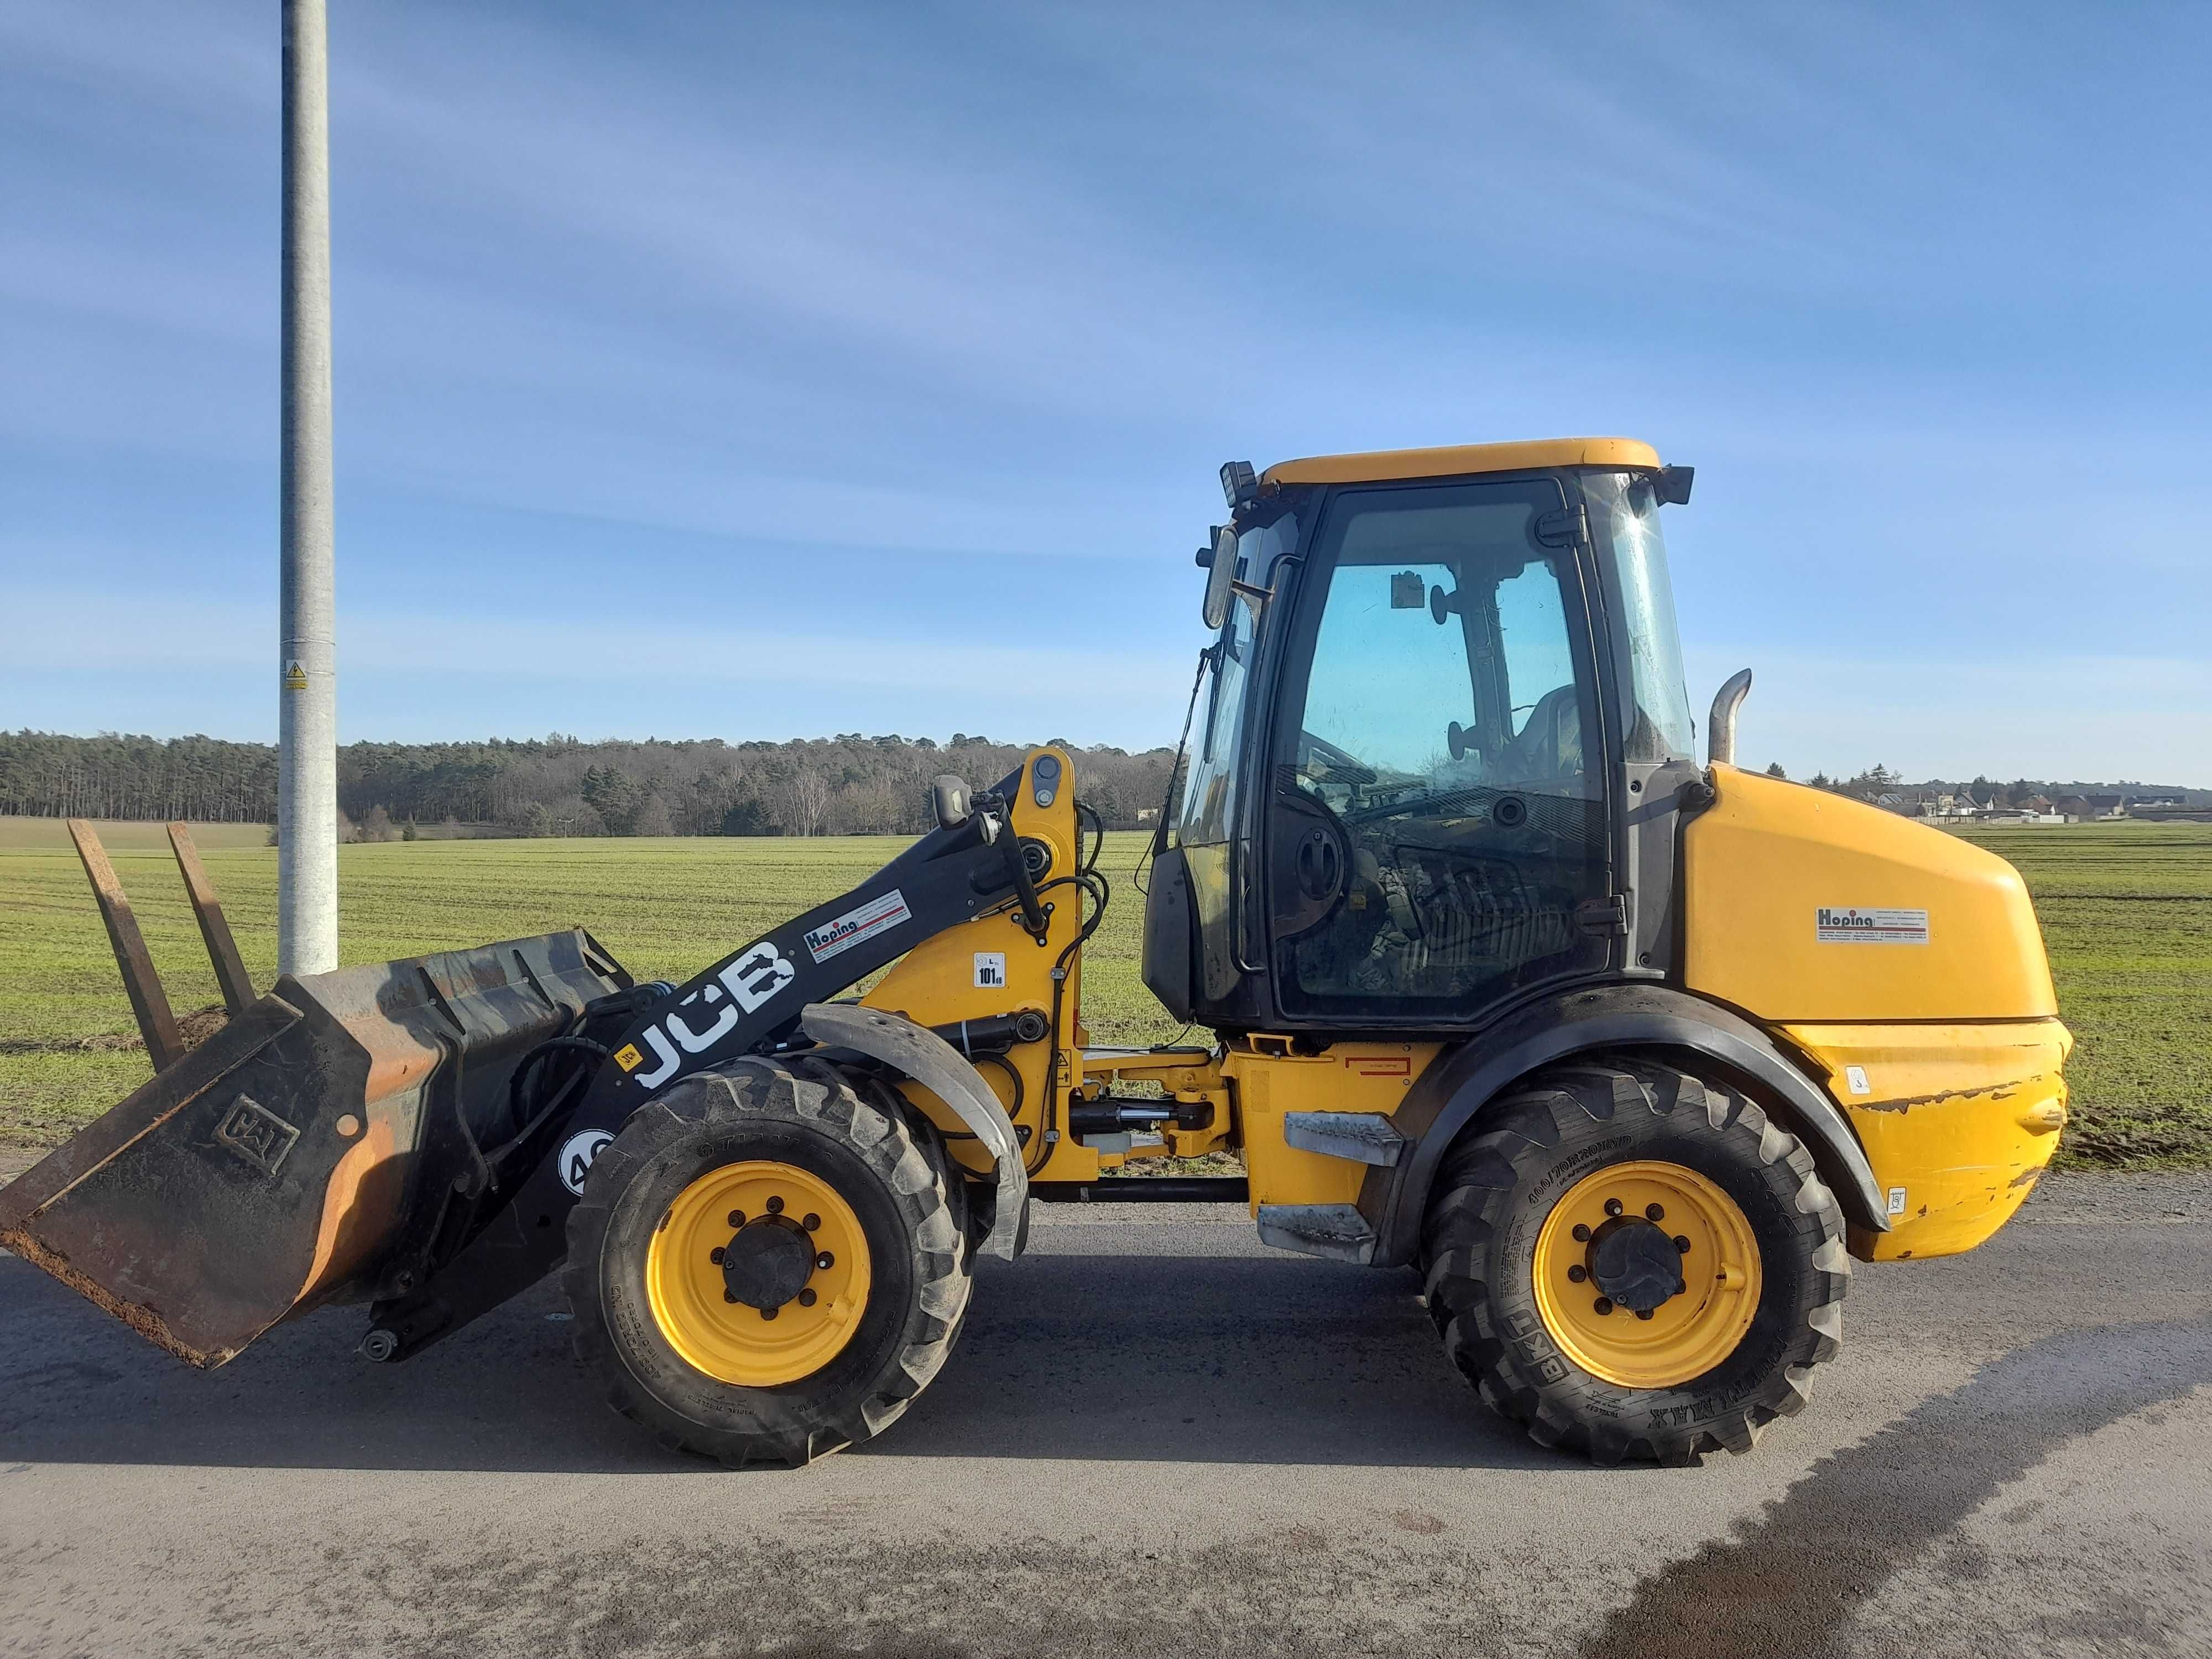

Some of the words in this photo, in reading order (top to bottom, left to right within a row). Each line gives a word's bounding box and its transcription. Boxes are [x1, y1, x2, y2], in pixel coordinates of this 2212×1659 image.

[1818, 909, 1873, 928] Hoping
[806, 921, 858, 949] Hoping
[979, 968, 995, 984] 101
[634, 942, 795, 1089] JCB
[621, 1051, 636, 1063] JCB
[223, 1106, 289, 1165] CAT
[1508, 1314, 1567, 1383] BKT
